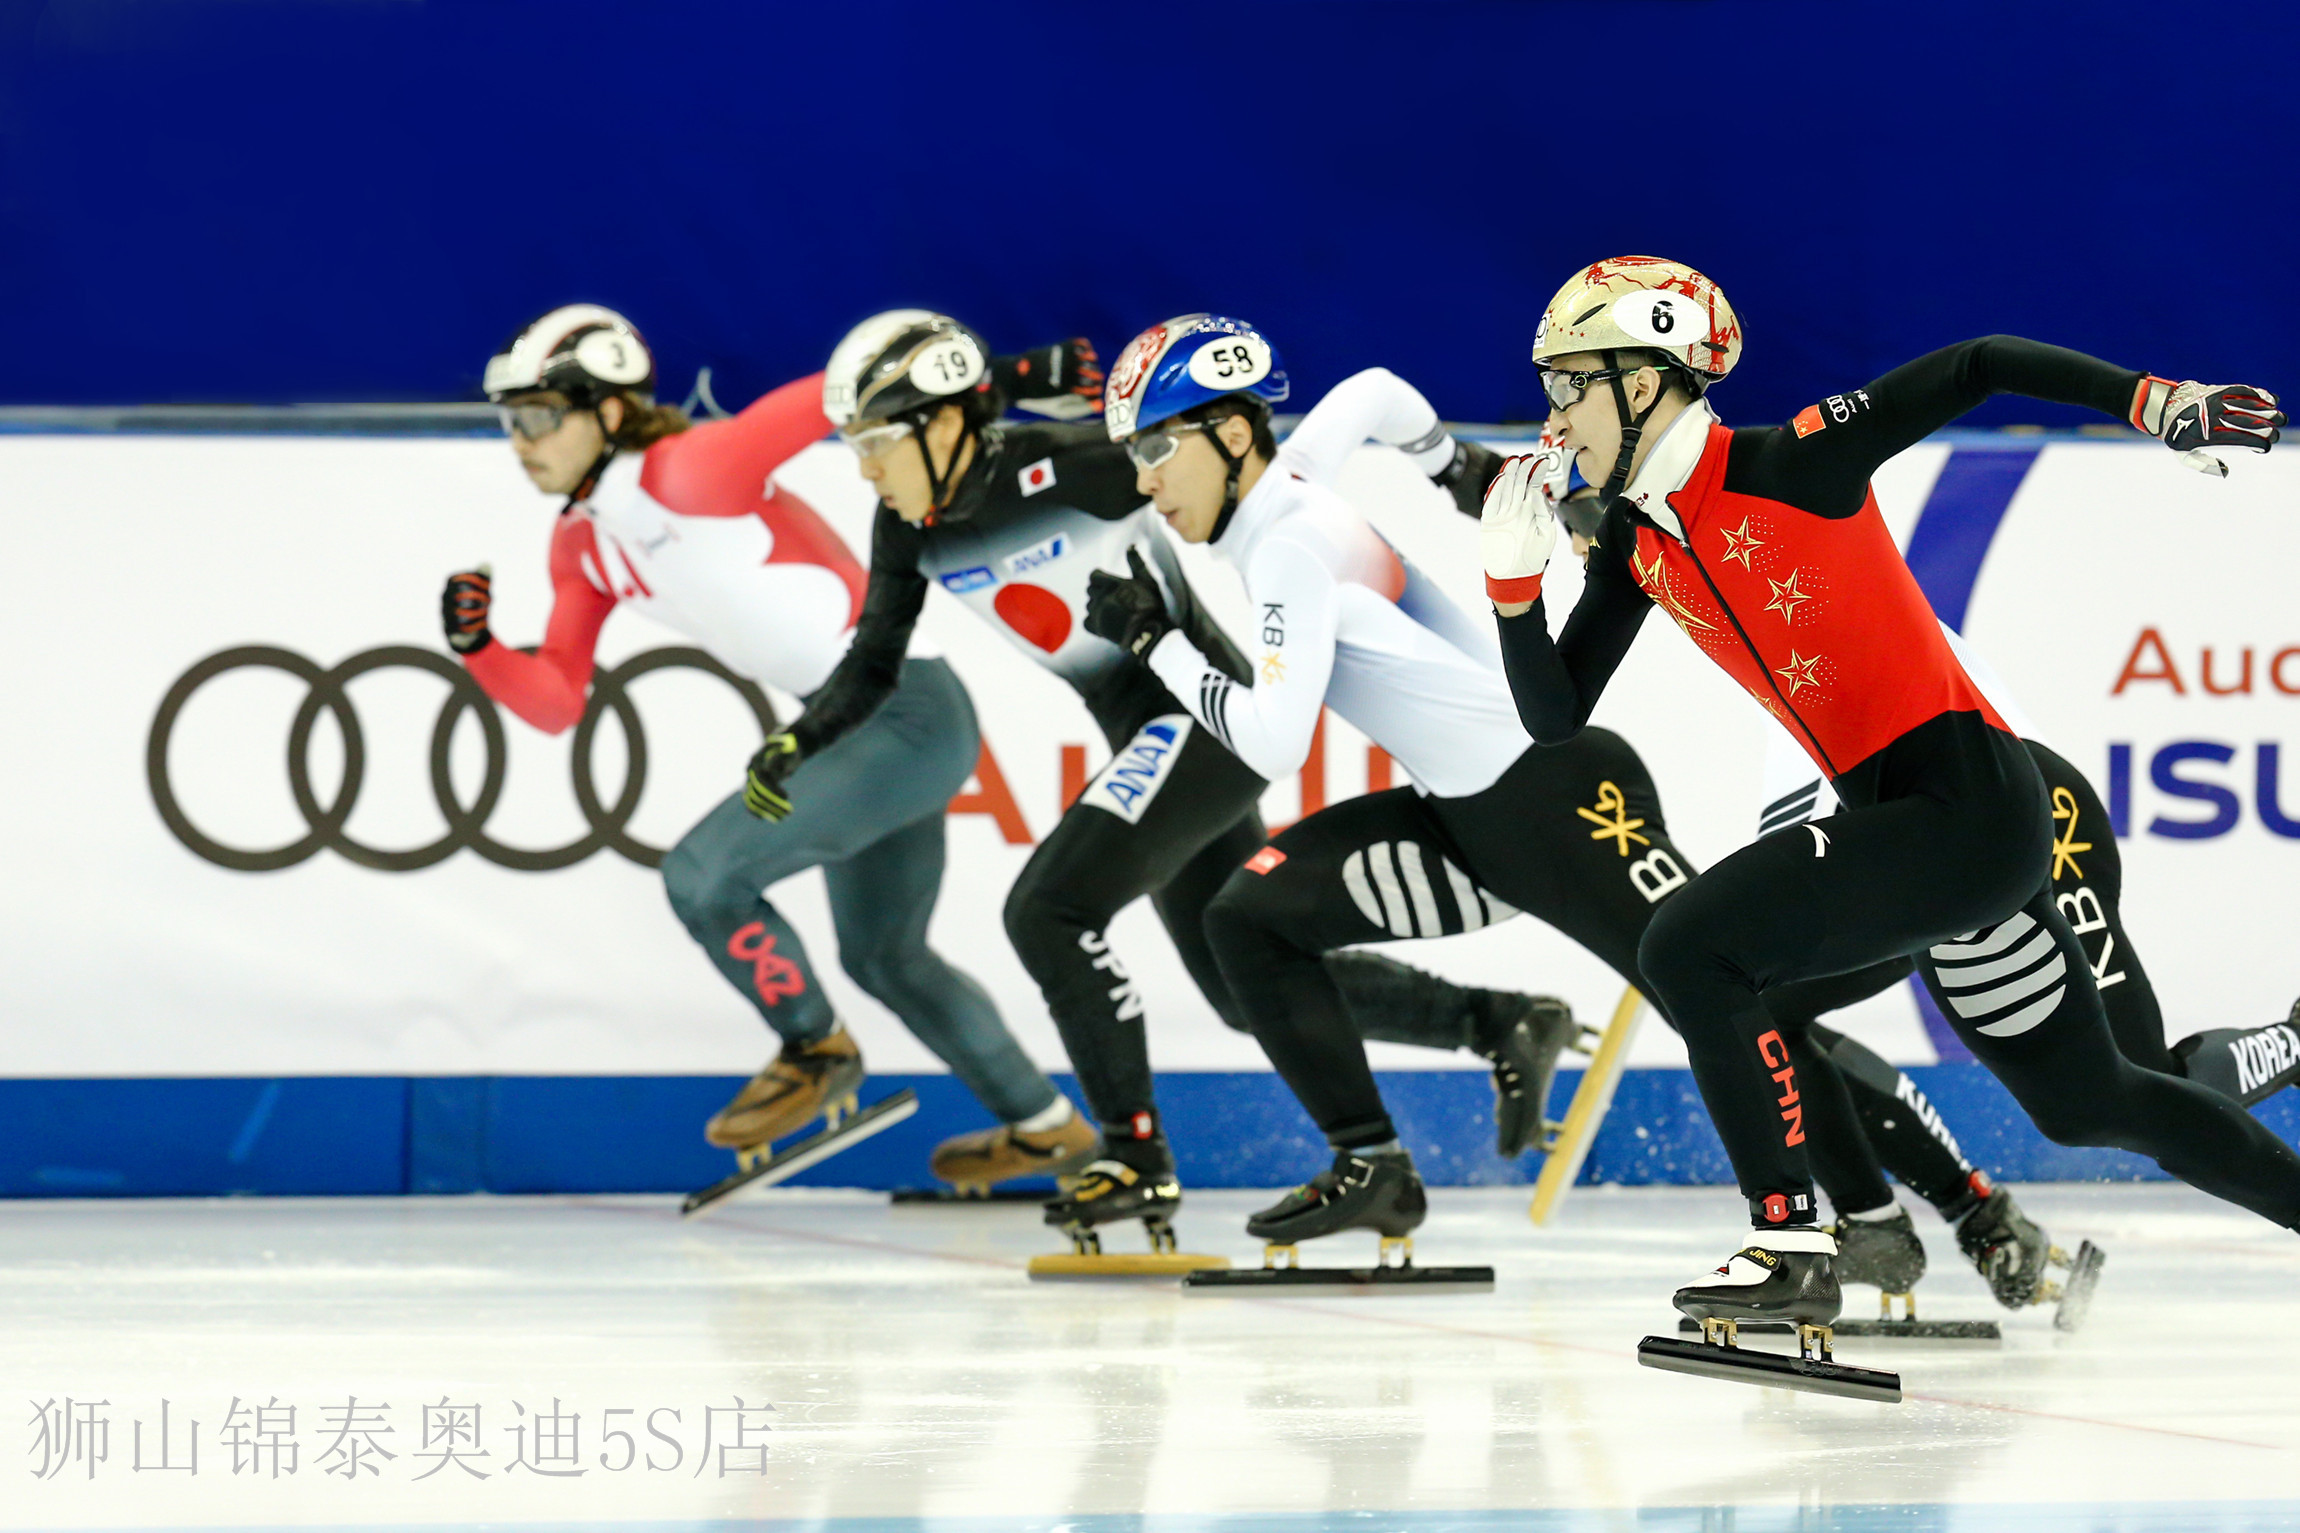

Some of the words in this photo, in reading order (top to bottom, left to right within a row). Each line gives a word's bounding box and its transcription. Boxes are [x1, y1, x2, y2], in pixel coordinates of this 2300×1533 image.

[1651, 300, 1675, 334] 6
[611, 341, 627, 370] 3
[933, 350, 969, 382] 19
[1212, 345, 1253, 378] 58
[1262, 602, 1285, 648] KB
[1106, 746, 1168, 813] ANA
[2056, 886, 2127, 990] KB
[1078, 930, 1143, 1022] JPN
[2227, 1024, 2300, 1095] KOREA
[1757, 1029, 1806, 1148] CHN
[1749, 1249, 1777, 1266] JING
